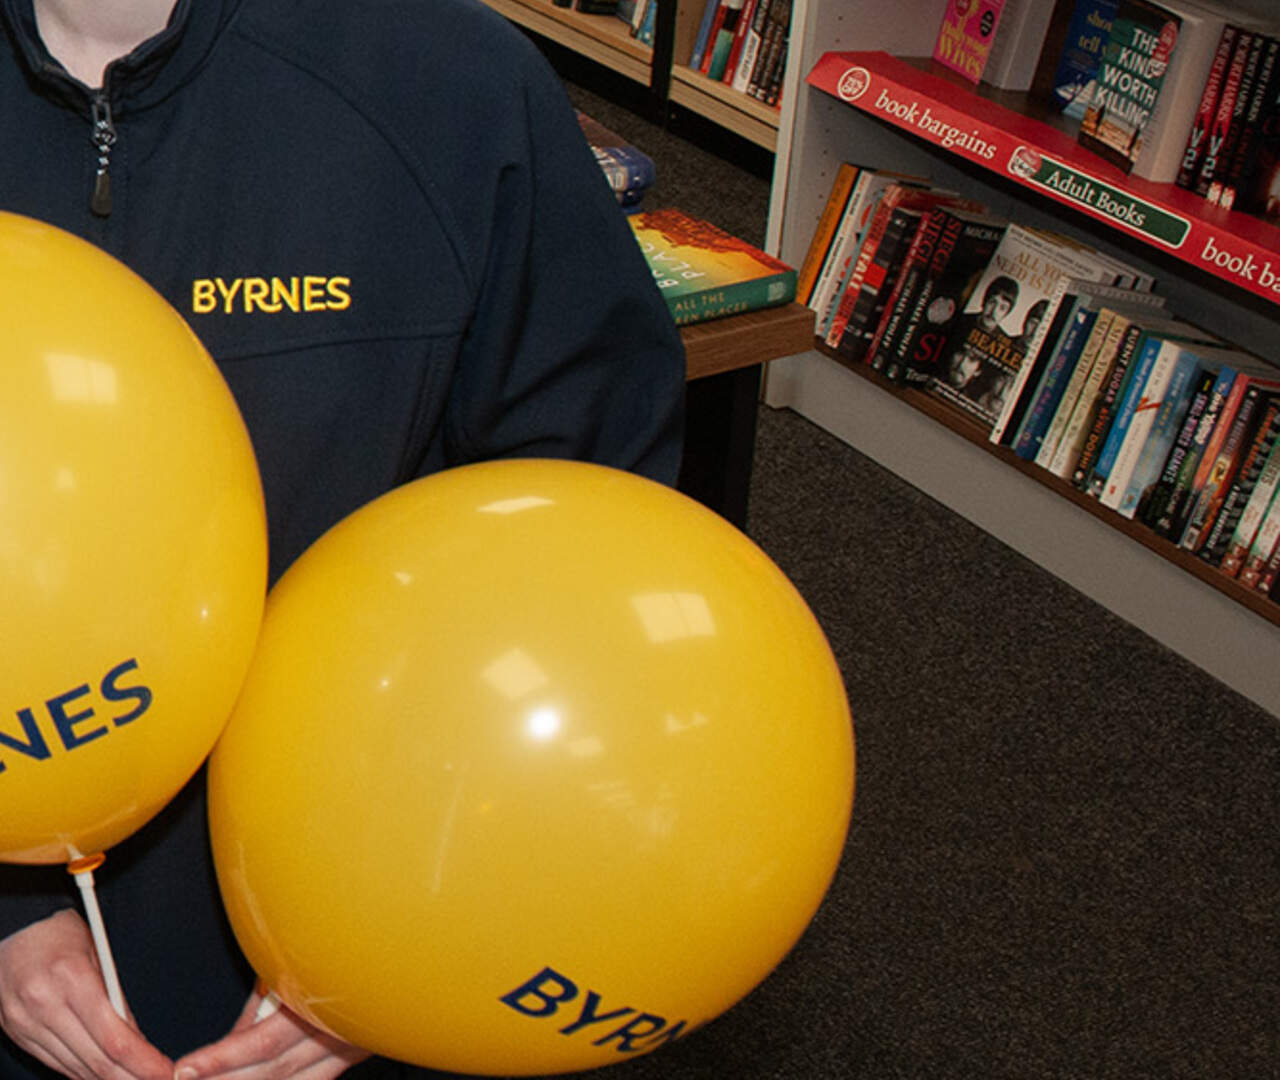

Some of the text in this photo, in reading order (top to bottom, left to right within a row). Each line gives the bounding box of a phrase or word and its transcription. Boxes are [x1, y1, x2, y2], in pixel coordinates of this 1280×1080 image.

[1103, 65, 1158, 107] WORTH
[875, 88, 997, 161] book bargains
[1095, 88, 1150, 129] KILLING
[1045, 169, 1145, 229] Adult Books
[1201, 237, 1256, 283] book
[192, 276, 350, 313] BYRNES
